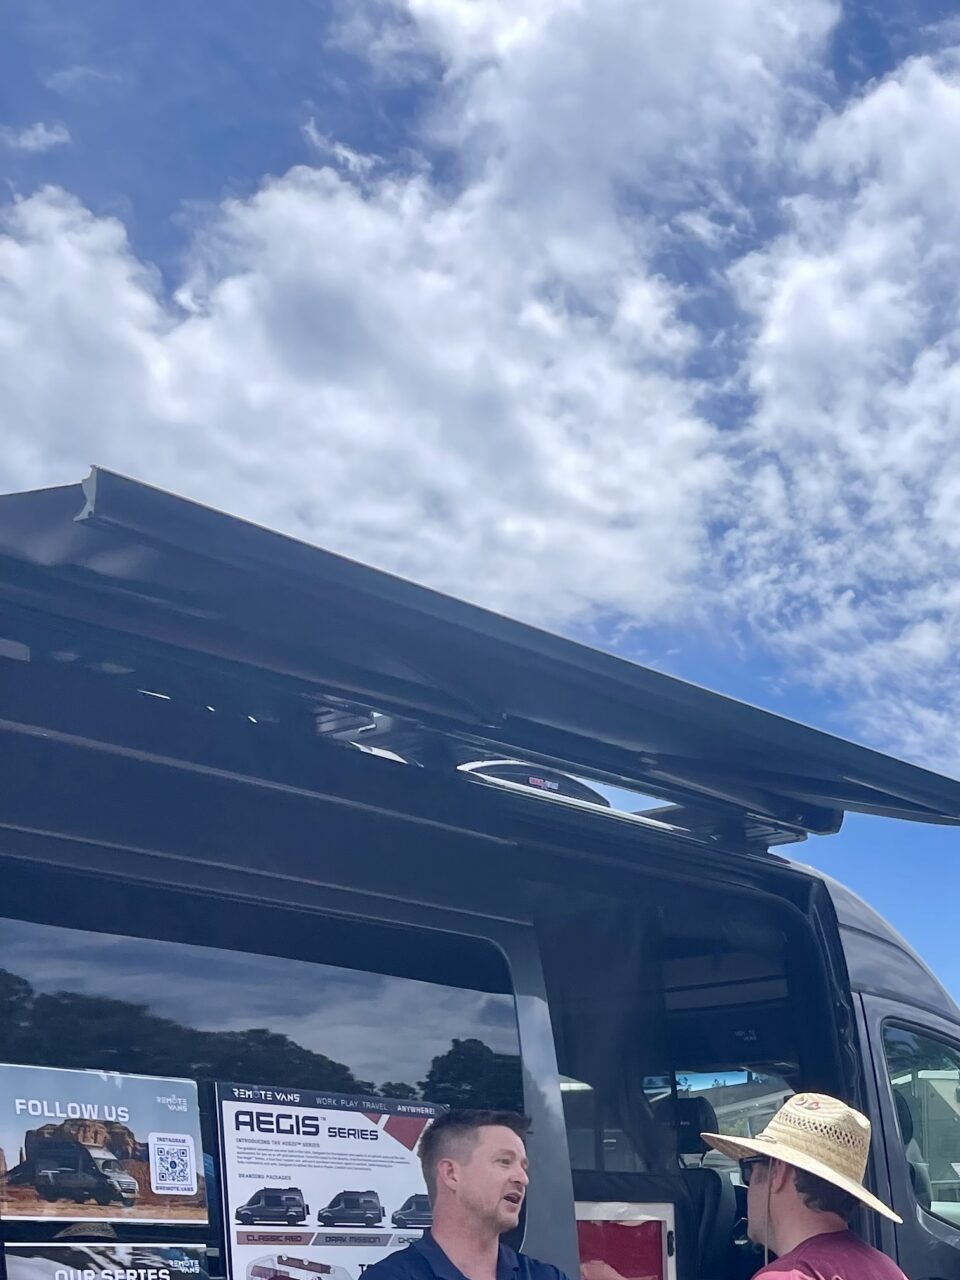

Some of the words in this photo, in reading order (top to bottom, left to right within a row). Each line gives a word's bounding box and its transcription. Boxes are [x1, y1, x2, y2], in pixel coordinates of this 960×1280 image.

[156, 1096, 187, 1104] REMOTE
[233, 1088, 272, 1100] REMOTE
[274, 1092, 300, 1102] VANS
[168, 1104, 188, 1112] VANS
[316, 1097, 336, 1106] WORK
[362, 1102, 388, 1110] TRAVEL
[16, 1099, 98, 1120] FOLLOW
[105, 1106, 129, 1122] US
[328, 1127, 378, 1140] SERIES
[169, 1258, 199, 1267] REMOTE
[180, 1266, 200, 1274] VANS
